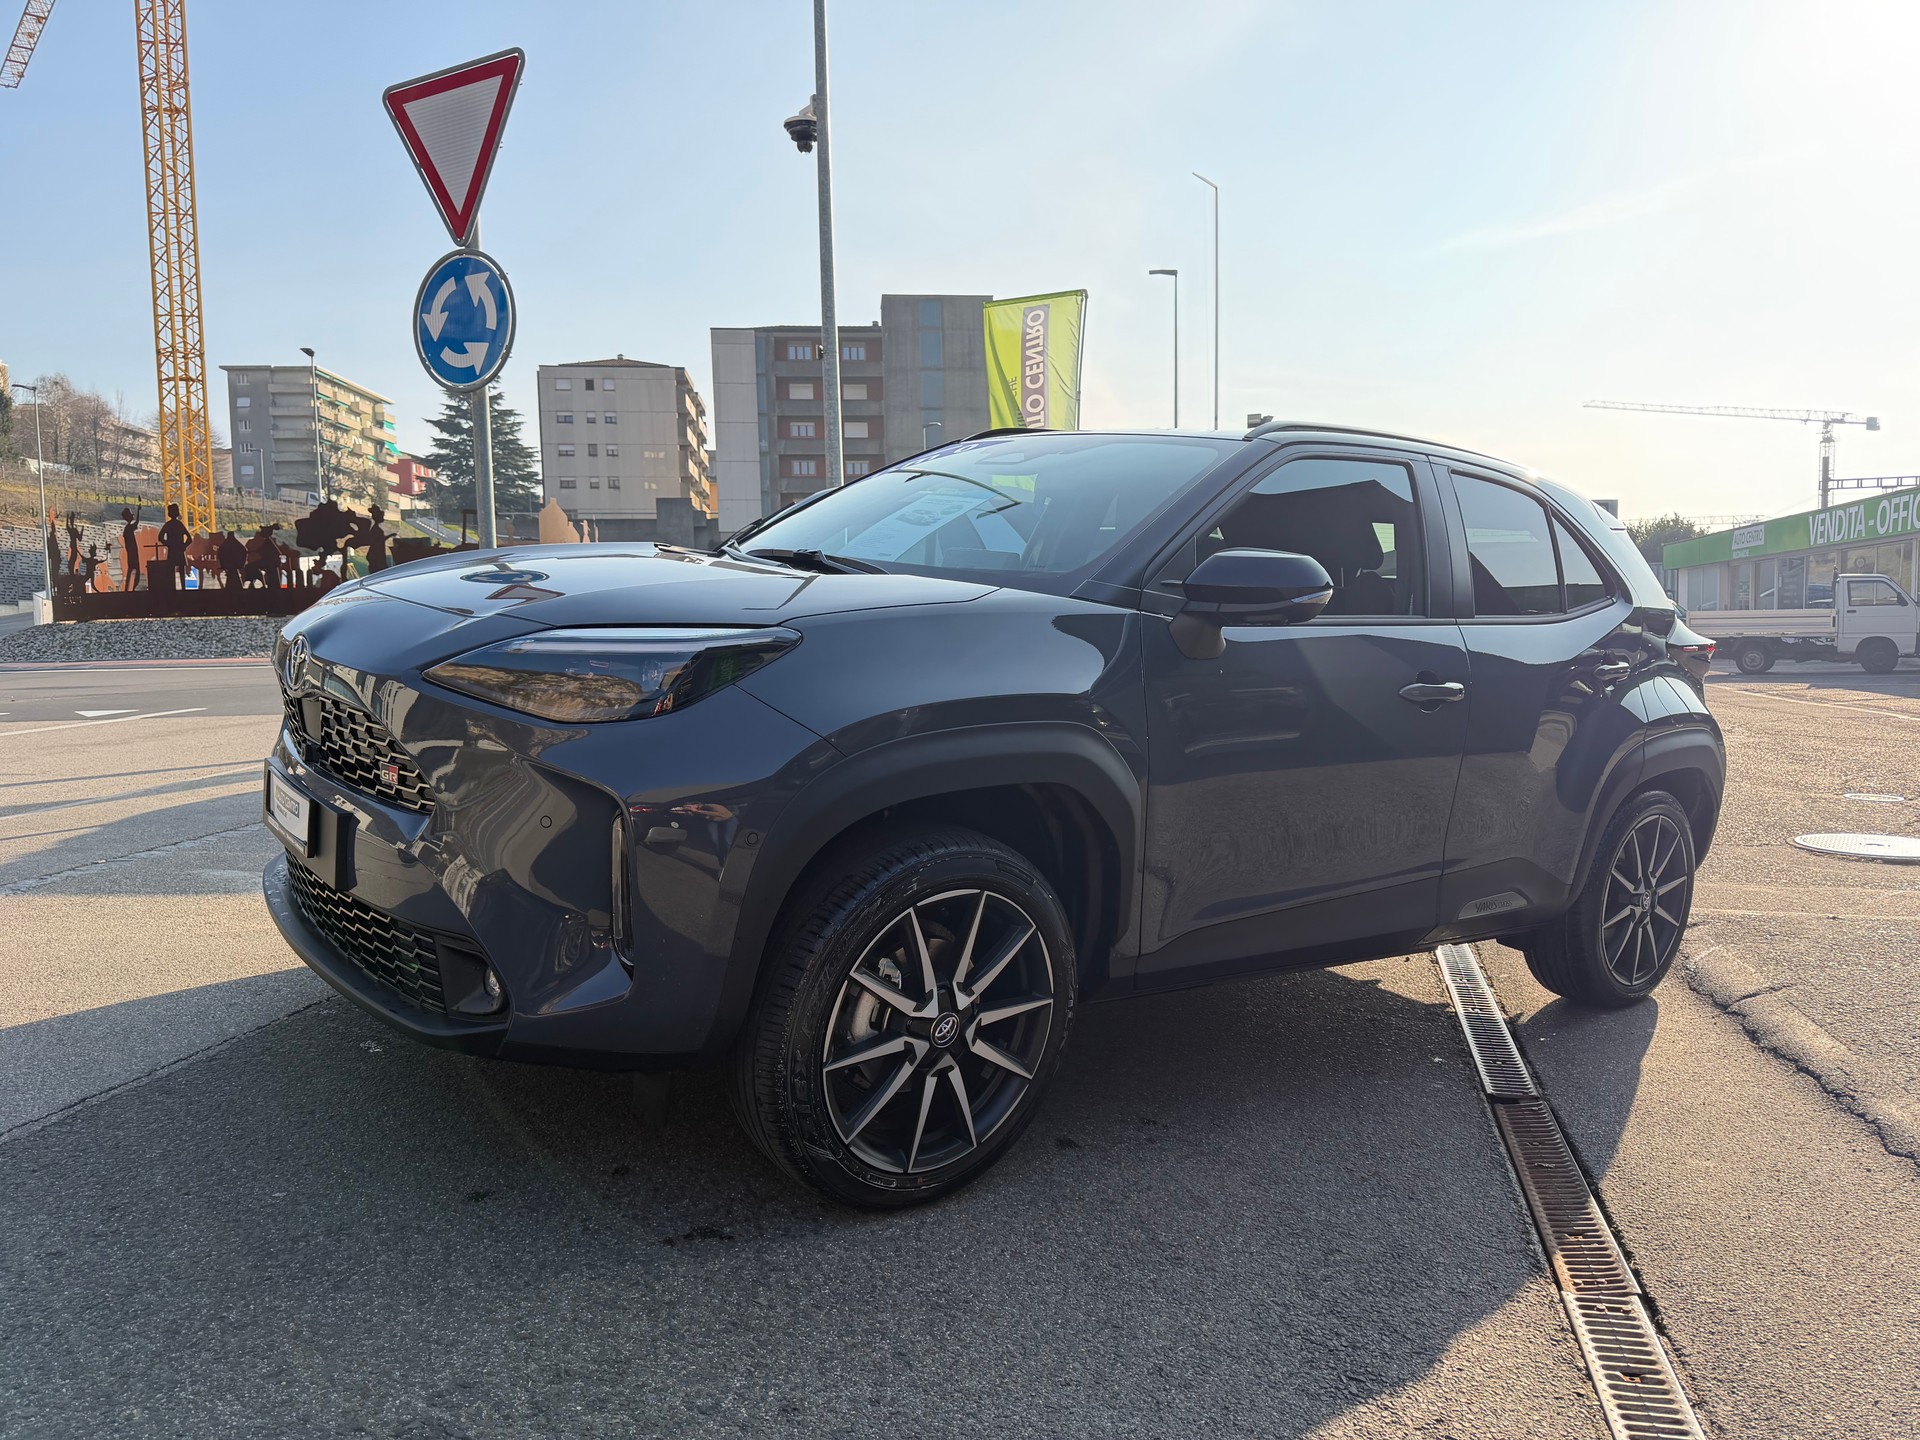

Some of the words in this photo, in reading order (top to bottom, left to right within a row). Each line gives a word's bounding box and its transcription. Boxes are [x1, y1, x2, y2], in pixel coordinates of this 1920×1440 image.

[1809, 505, 1866, 545] VENDITA
[381, 769, 397, 782] GR
[1475, 900, 1497, 912] YARIS
